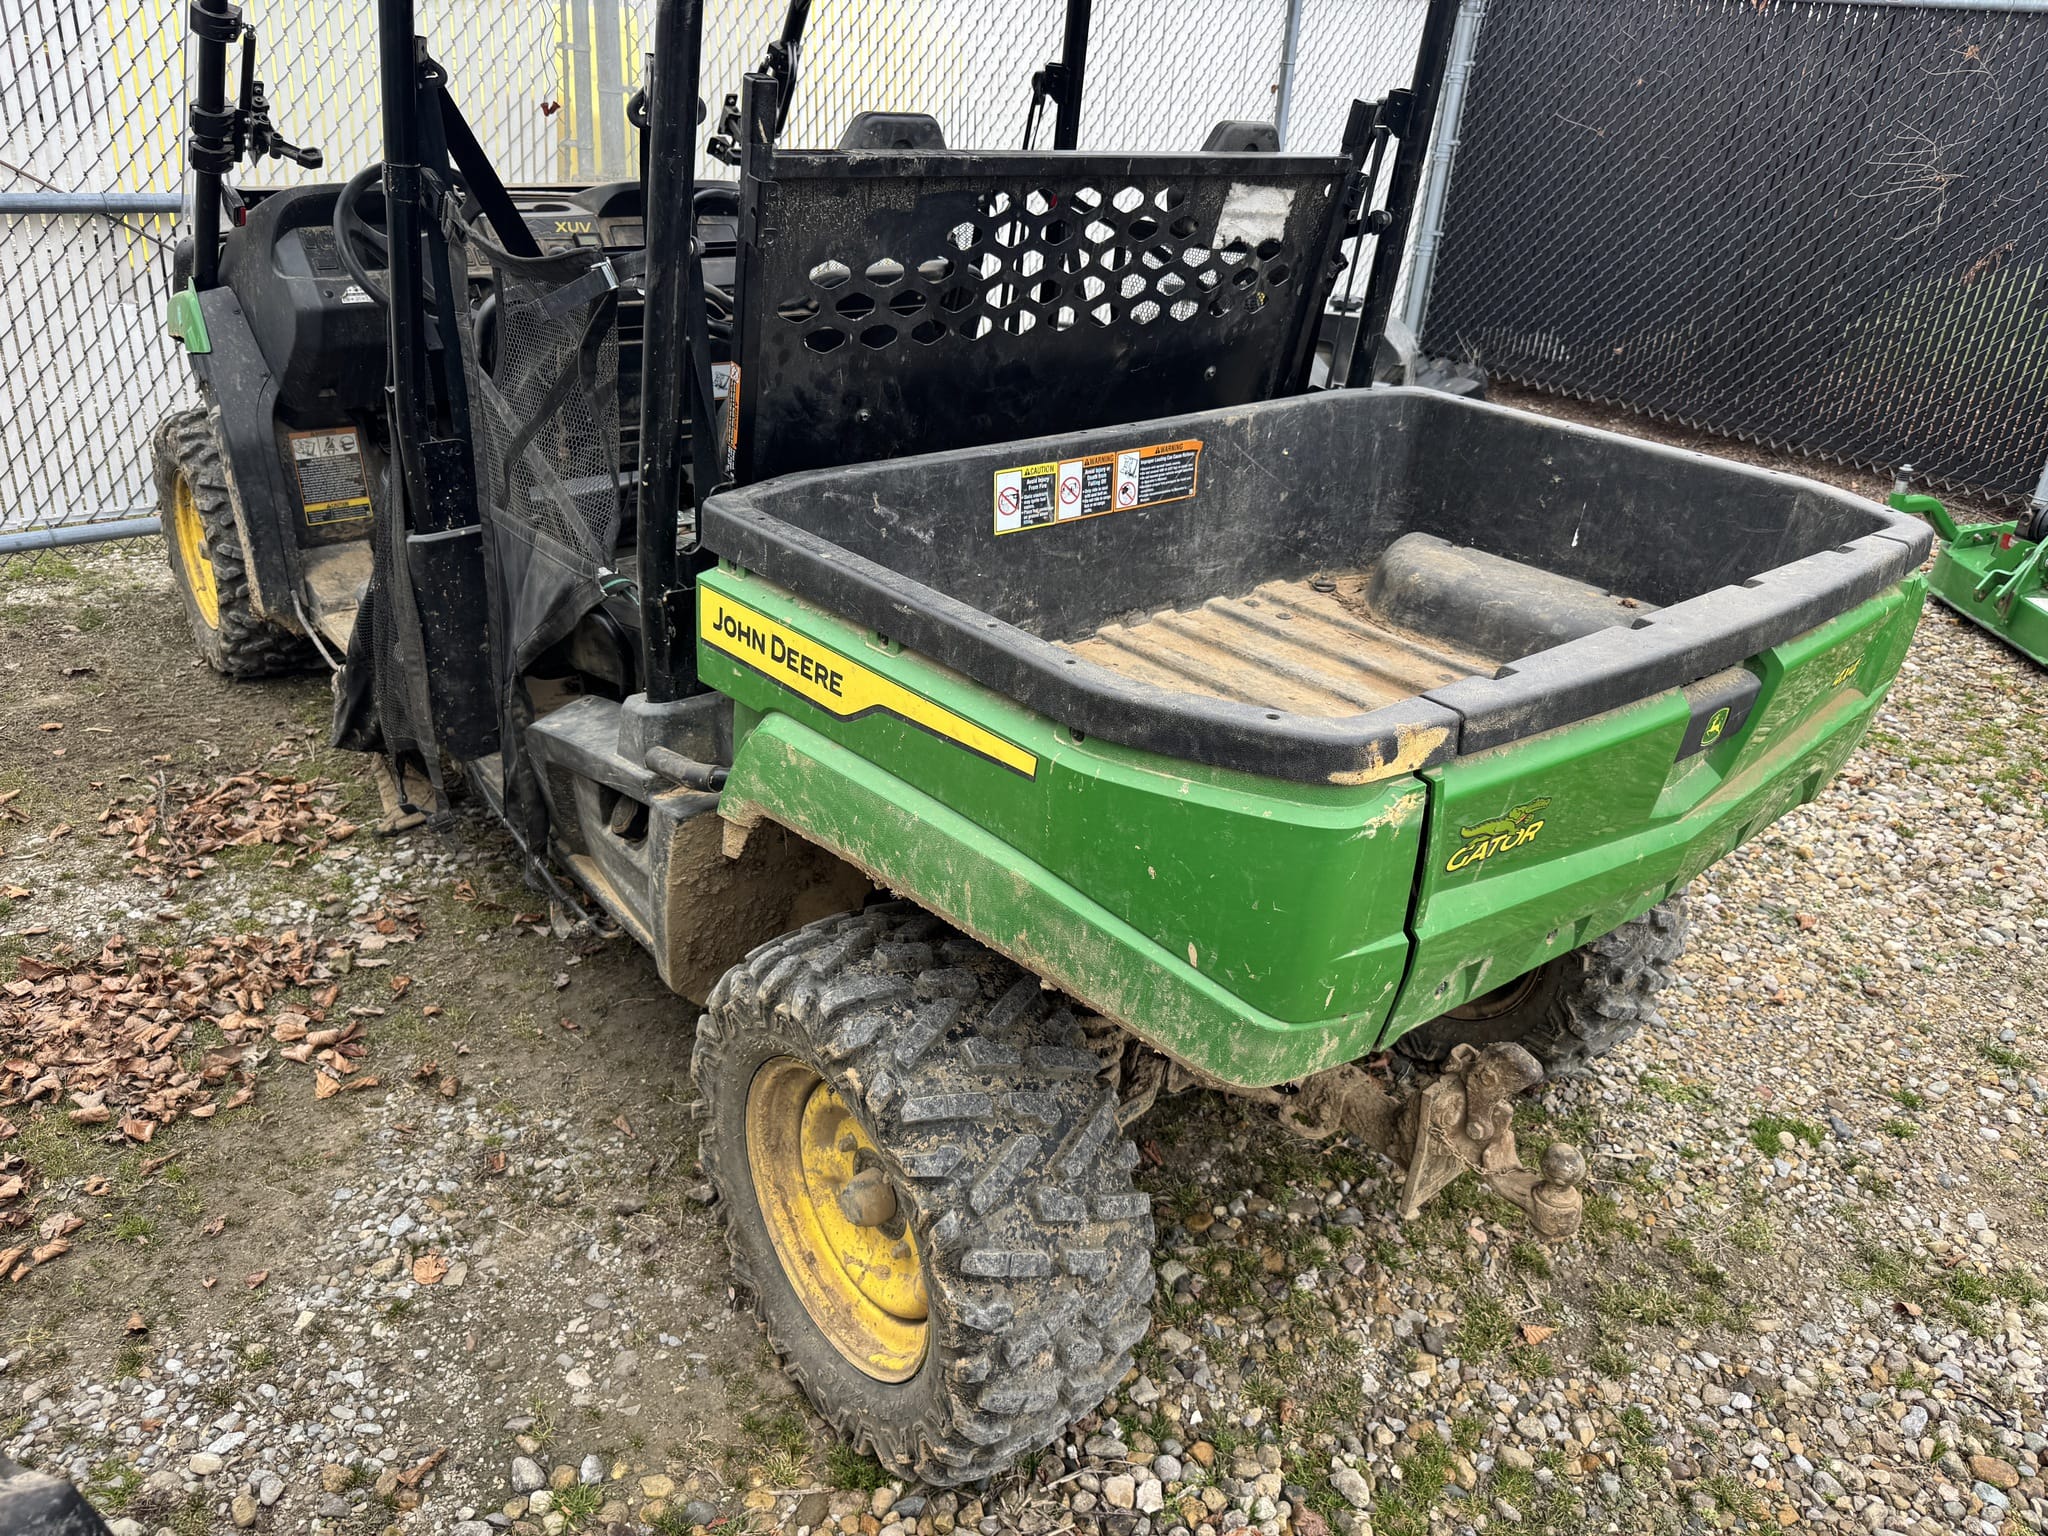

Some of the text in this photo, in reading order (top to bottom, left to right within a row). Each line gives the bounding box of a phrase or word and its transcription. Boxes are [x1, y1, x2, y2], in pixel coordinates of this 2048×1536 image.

[554, 220, 591, 233] XUV
[1161, 443, 1184, 453] WARNING
[1090, 454, 1114, 464] WARNING
[1031, 464, 1055, 475] CAUTION
[712, 607, 844, 697] JOHN DEERE
[1446, 820, 1545, 872] GATOR
